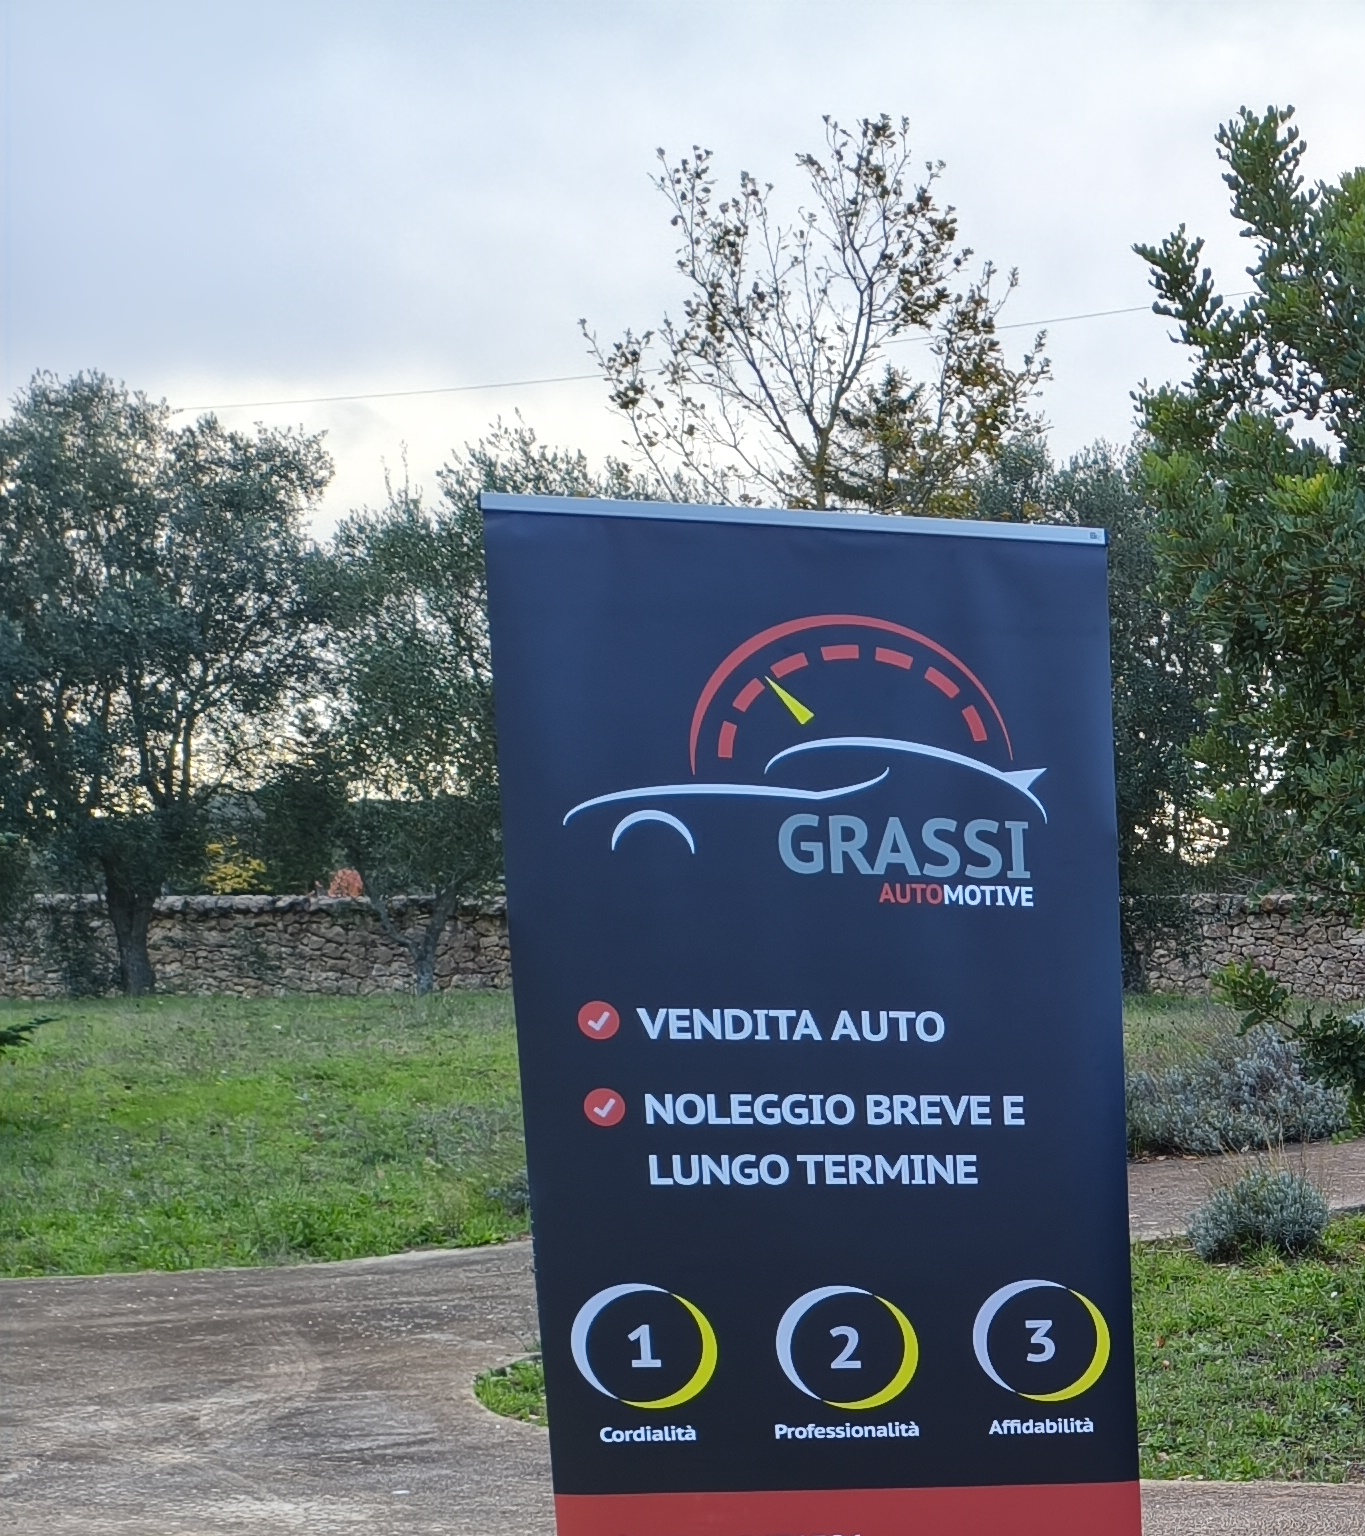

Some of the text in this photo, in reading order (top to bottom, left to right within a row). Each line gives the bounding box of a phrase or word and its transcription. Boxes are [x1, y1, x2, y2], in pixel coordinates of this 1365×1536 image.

[777, 813, 1031, 879] GRASSI
[879, 882, 1035, 908] AUTOMOTIVE
[636, 1007, 945, 1042] VENDITA AUTO
[645, 1093, 1026, 1126] NOLEGGIO BREVE E
[648, 1154, 979, 1186] LUNGO TERMINE
[627, 1323, 662, 1368] 1
[829, 1325, 862, 1369] 2
[1024, 1319, 1056, 1363] 3
[599, 1424, 697, 1443] Cordialità
[774, 1421, 920, 1440] Professionalità
[988, 1417, 1094, 1436] Affidabilità
